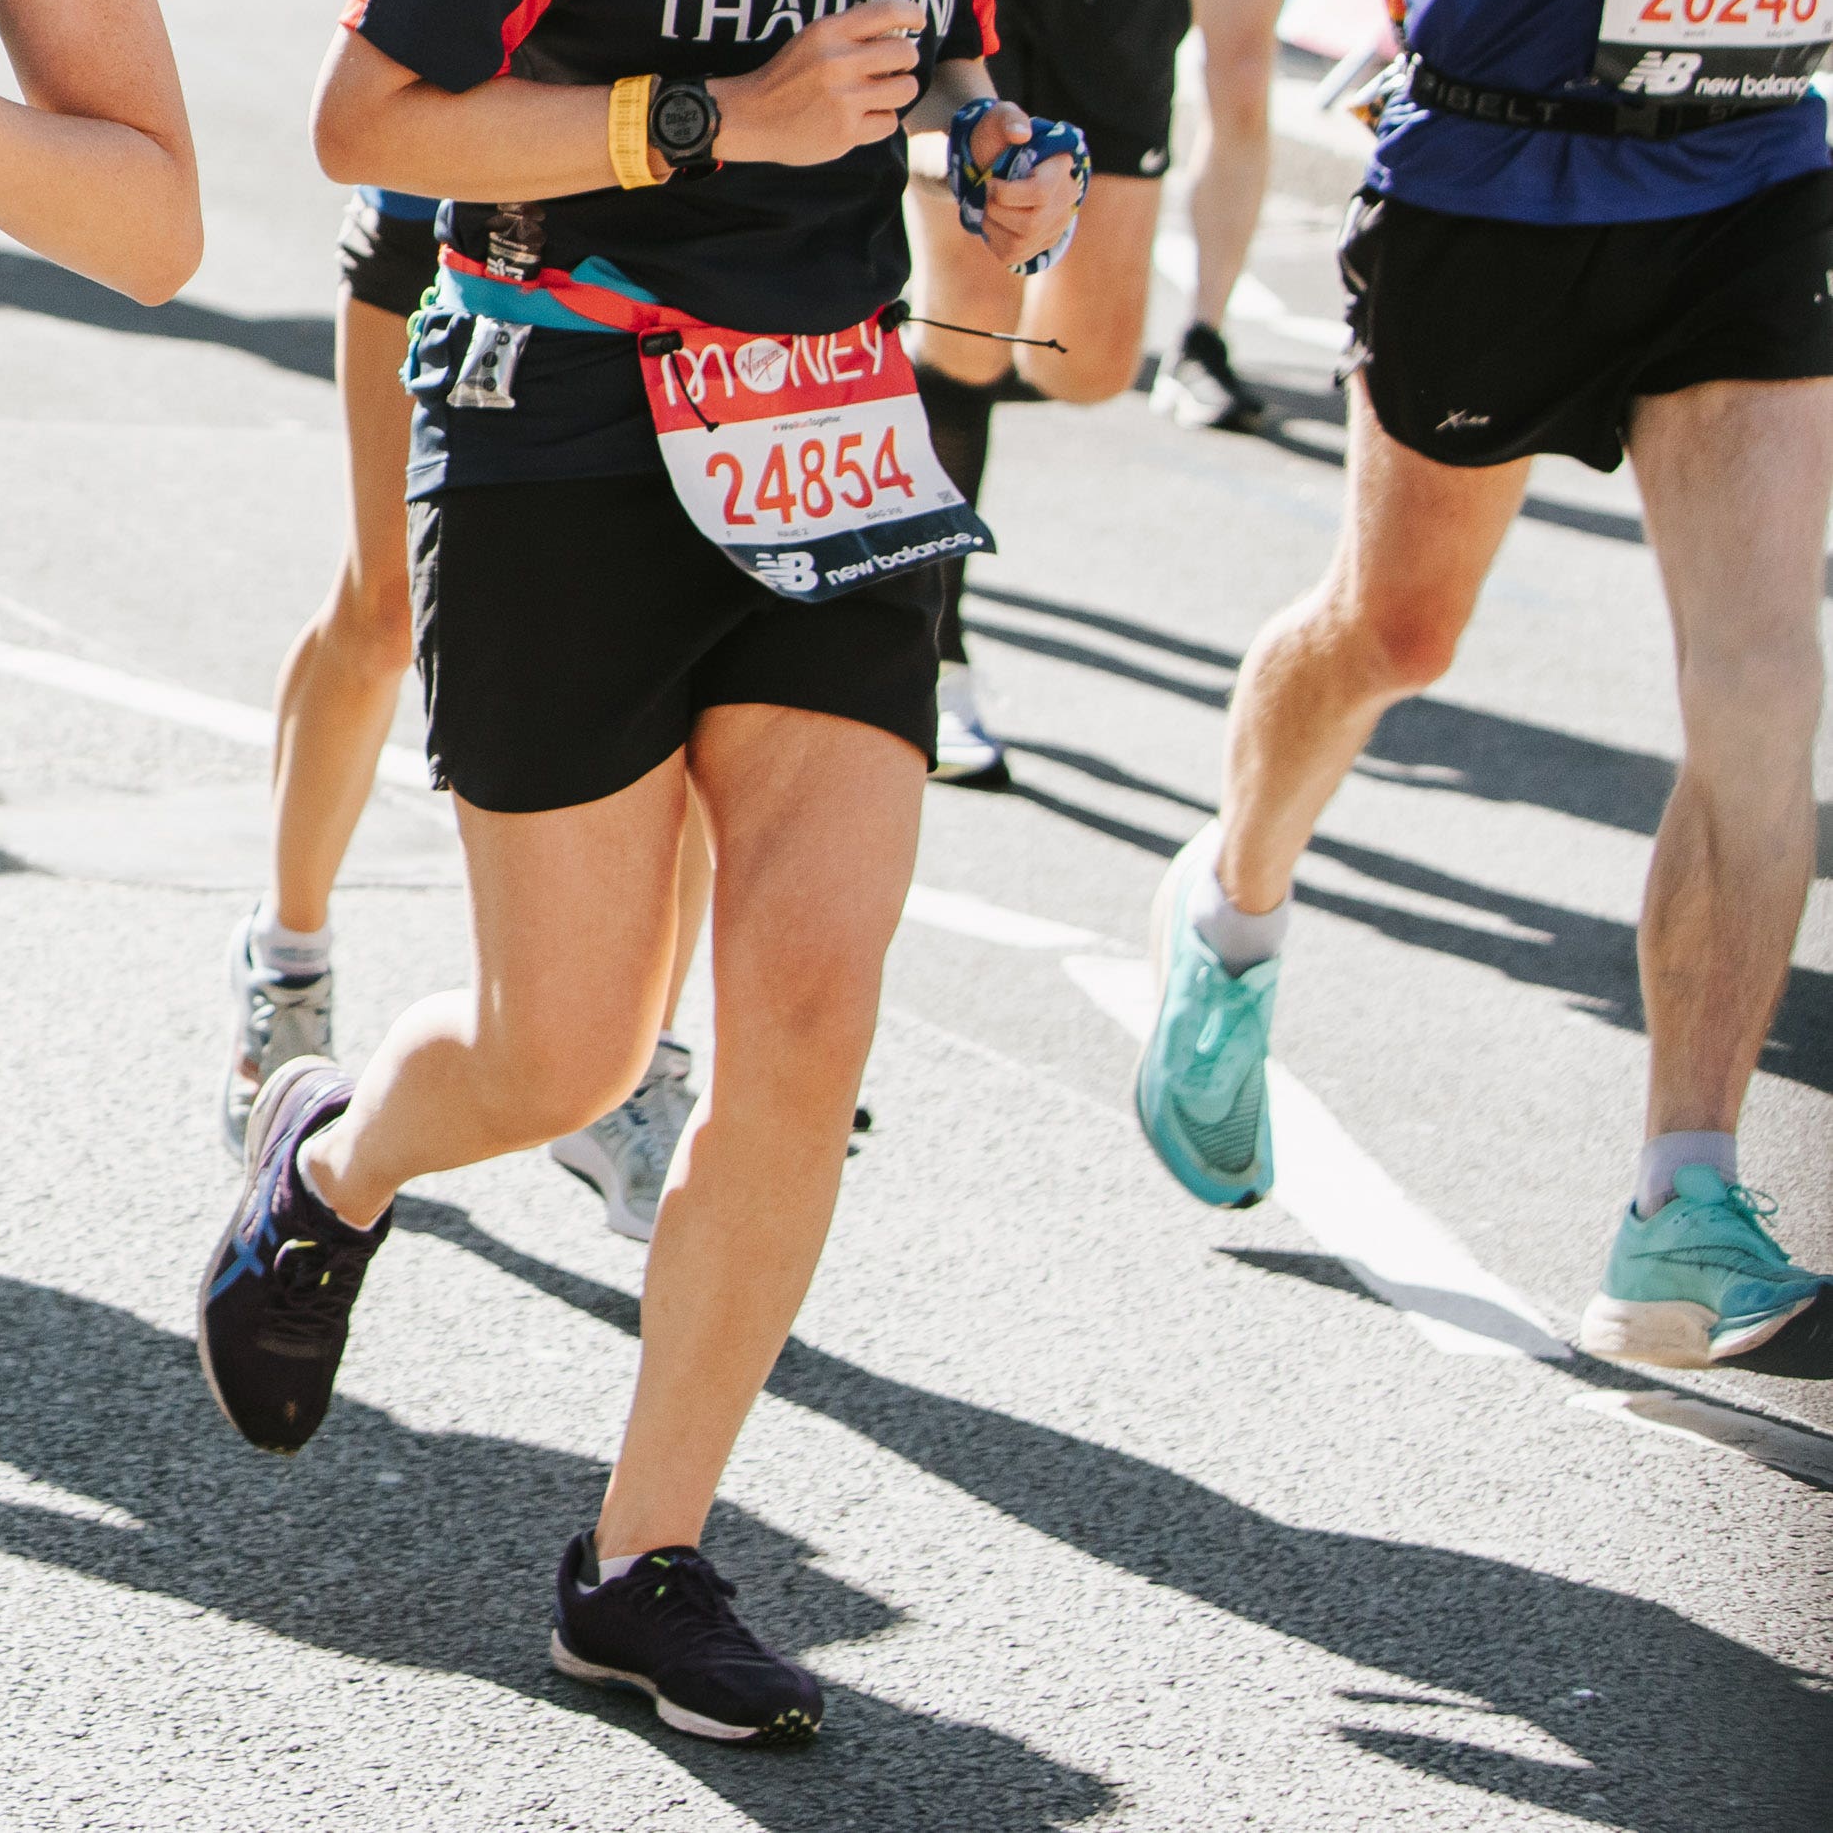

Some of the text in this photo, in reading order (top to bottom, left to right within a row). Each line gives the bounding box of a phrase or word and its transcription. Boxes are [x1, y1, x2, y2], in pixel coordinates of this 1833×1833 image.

[1695, 74, 1739, 96] new
[661, 322, 882, 406] MONEY
[705, 425, 916, 527] 24854
[824, 554, 875, 587] new
